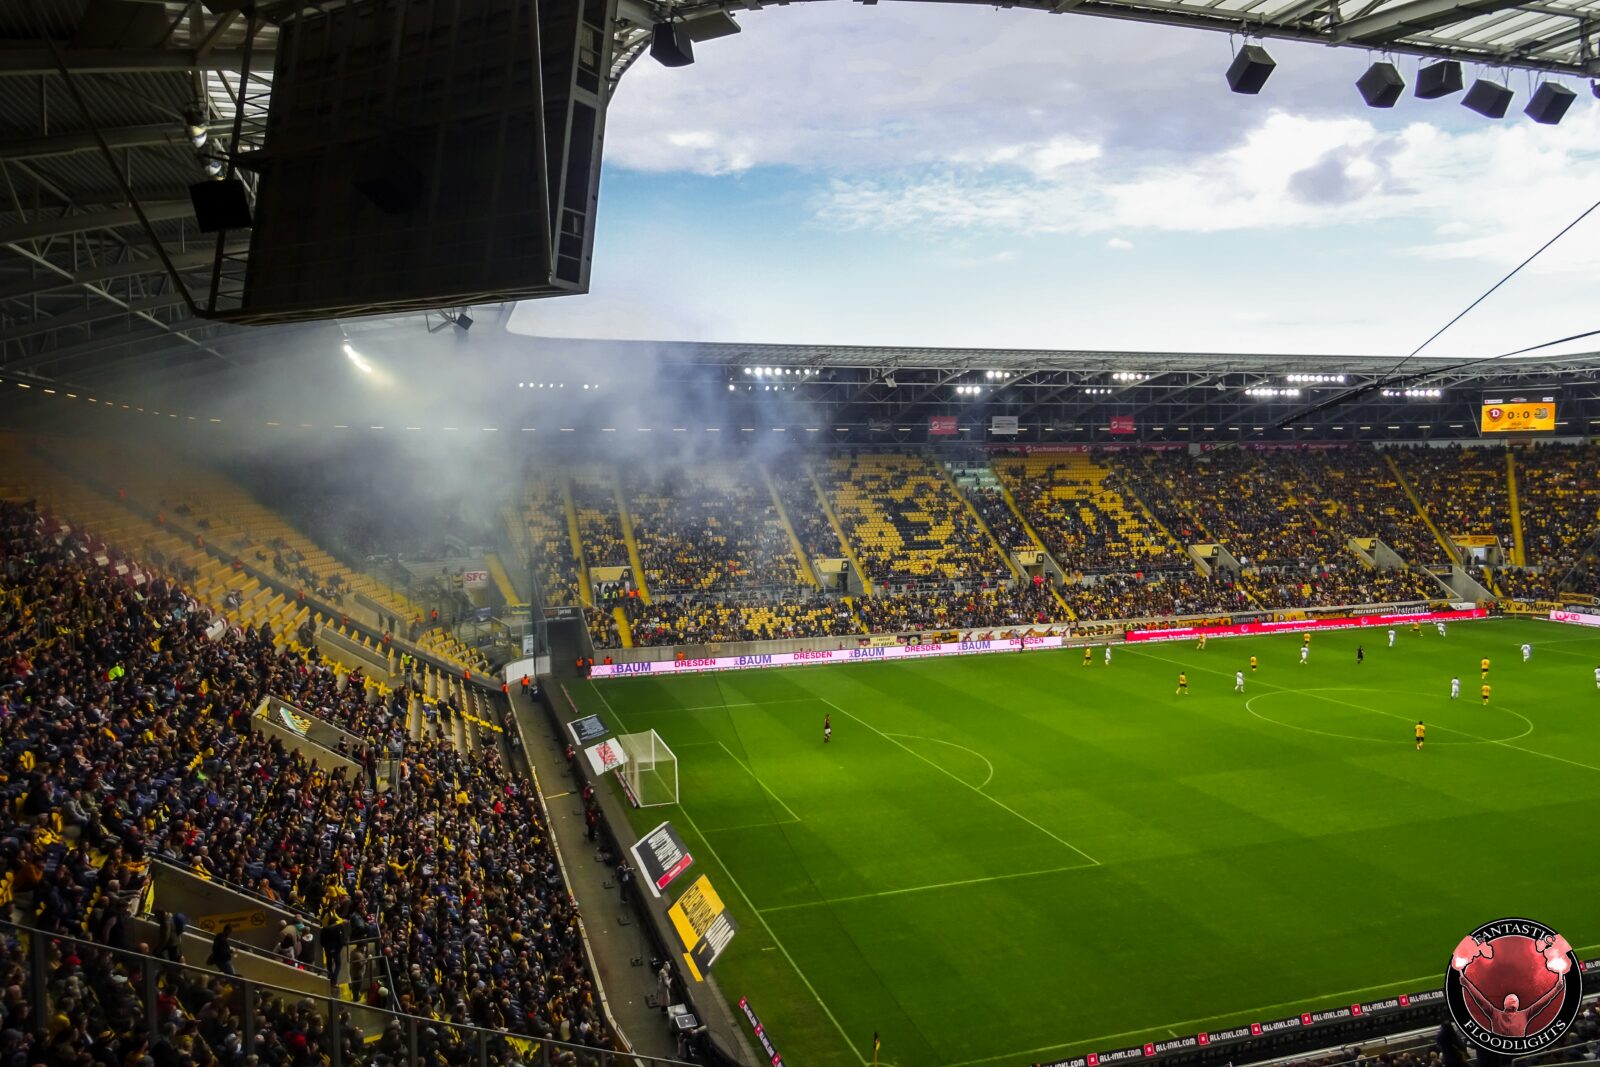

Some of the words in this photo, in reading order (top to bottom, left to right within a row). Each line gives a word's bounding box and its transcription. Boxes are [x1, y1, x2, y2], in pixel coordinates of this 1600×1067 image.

[905, 644, 942, 653] DRESDEN
[962, 641, 991, 651] BAUM
[793, 651, 832, 661] DRESDEN
[855, 647, 885, 658] BAUM
[675, 658, 716, 668] DRESDEN
[740, 655, 772, 666] BAUM
[616, 662, 651, 673] BAUM
